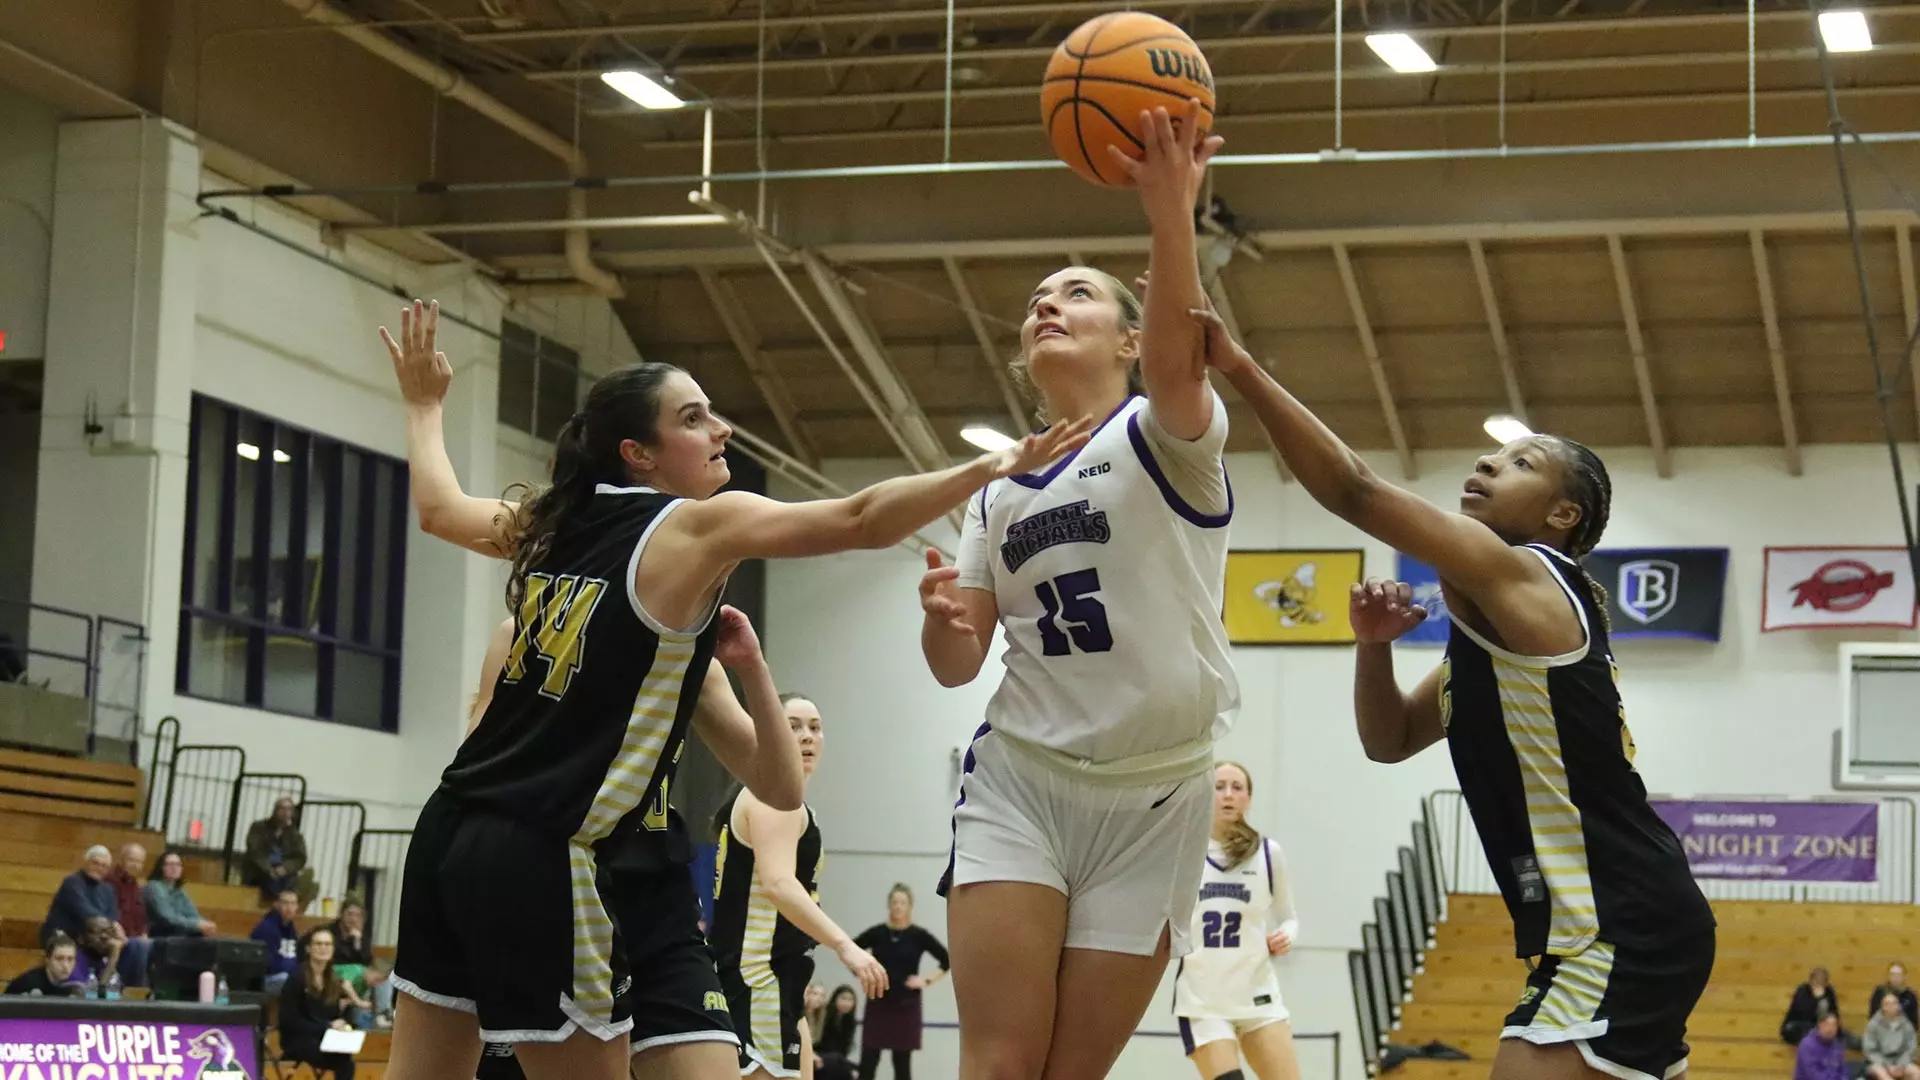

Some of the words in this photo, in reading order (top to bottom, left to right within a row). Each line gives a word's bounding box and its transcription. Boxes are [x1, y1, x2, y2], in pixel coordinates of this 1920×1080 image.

[1007, 499, 1090, 543] SAINT
[1632, 569, 1666, 608] B
[1035, 568, 1114, 656] 15
[503, 572, 610, 702] 14
[1677, 832, 1784, 857] NIGHT
[1793, 835, 1877, 858] ZONE
[1202, 911, 1242, 948] 22
[35, 1043, 55, 1062] OF
[56, 1044, 82, 1062] THE
[78, 1024, 183, 1063] PURPLE
